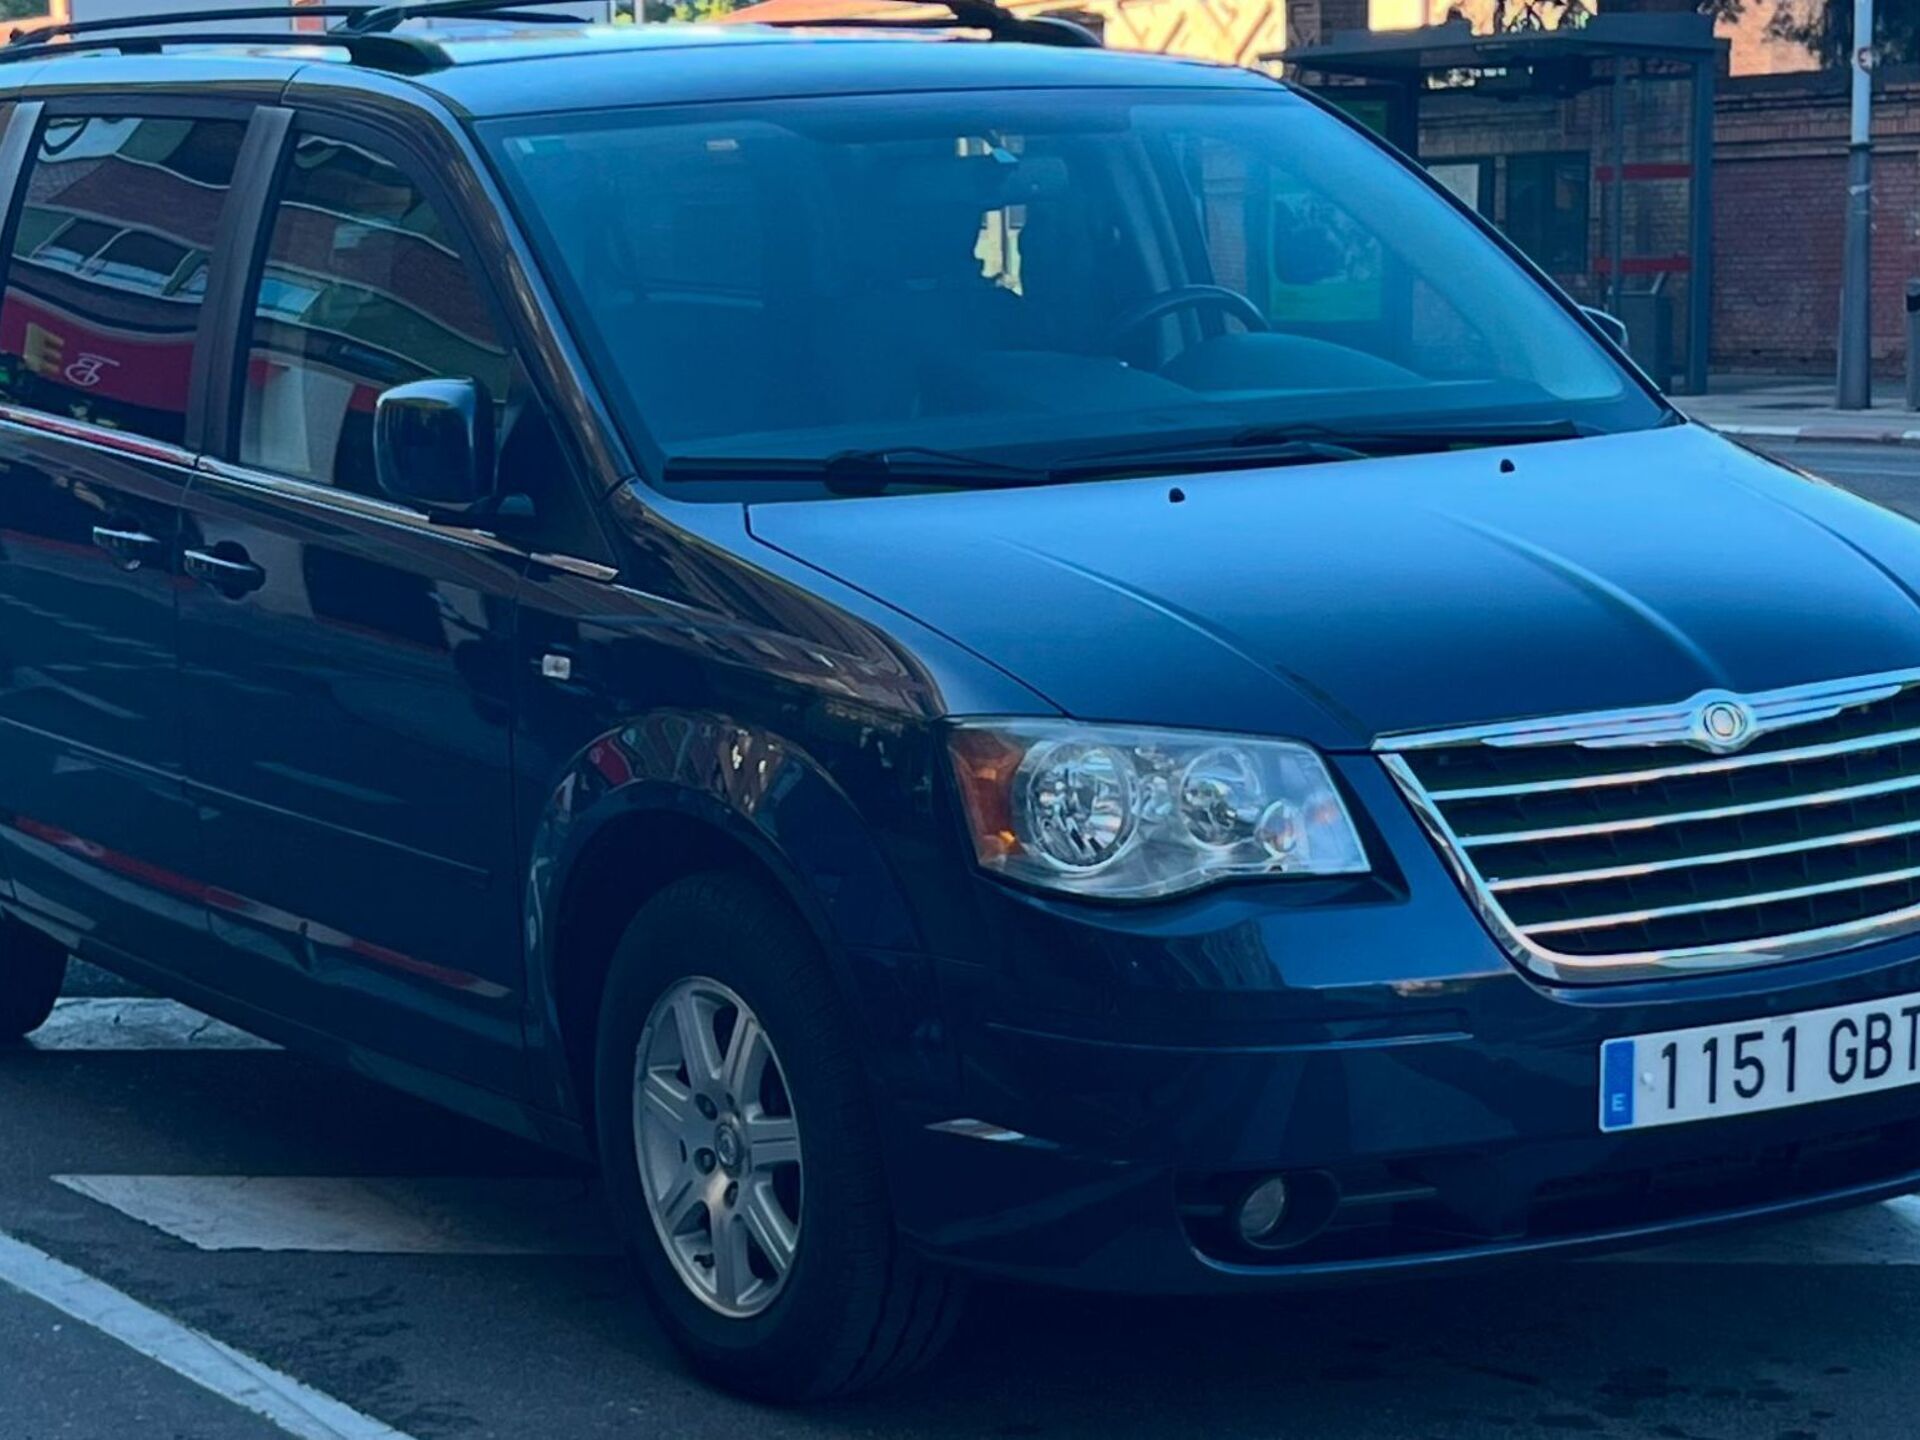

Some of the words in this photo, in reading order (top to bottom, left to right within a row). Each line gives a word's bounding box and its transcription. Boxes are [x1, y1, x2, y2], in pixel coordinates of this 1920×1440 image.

[1661, 1026, 1797, 1109] 1151
[1828, 1006, 1920, 1084] GBT
[1611, 1093, 1625, 1112] E
